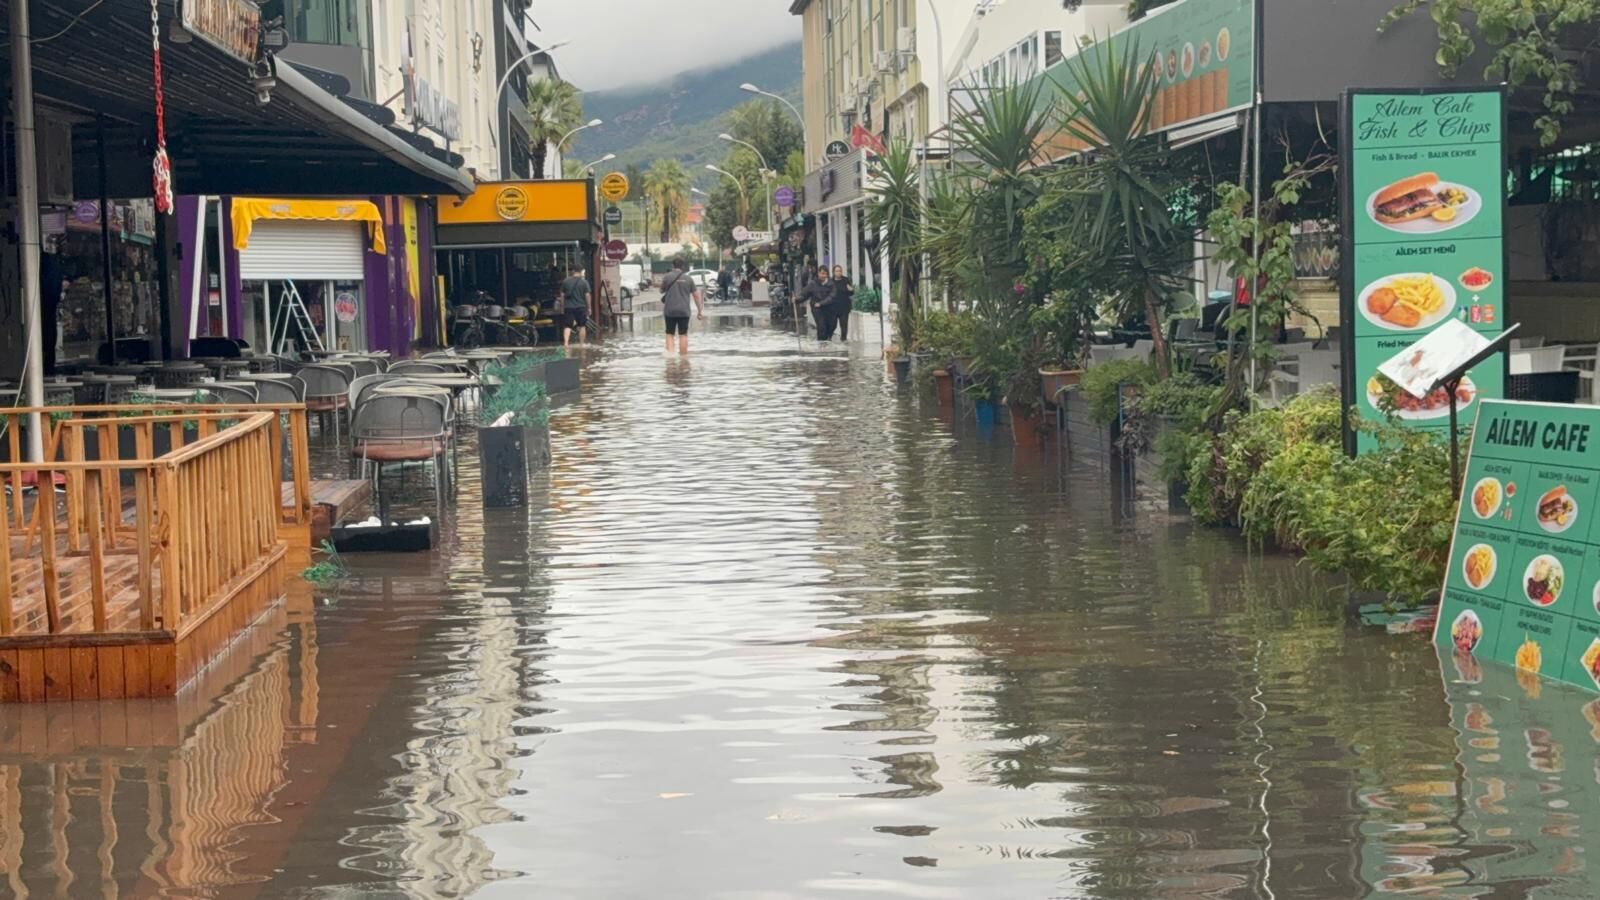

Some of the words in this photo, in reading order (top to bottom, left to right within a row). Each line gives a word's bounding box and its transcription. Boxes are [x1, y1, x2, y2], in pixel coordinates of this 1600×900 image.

[1366, 98, 1423, 121] Ailem
[1432, 95, 1474, 117] Cafe
[1359, 120, 1398, 141] Fish
[1408, 119, 1428, 138] &
[1437, 116, 1492, 142] Chips
[1372, 153, 1387, 161] Fish
[1395, 152, 1418, 161] Bread
[1419, 246, 1432, 255] SET
[1434, 244, 1456, 254] MENÜ
[1377, 340, 1396, 348] Fried
[1485, 411, 1538, 448] AİLEM
[1542, 422, 1590, 452] CAFE
